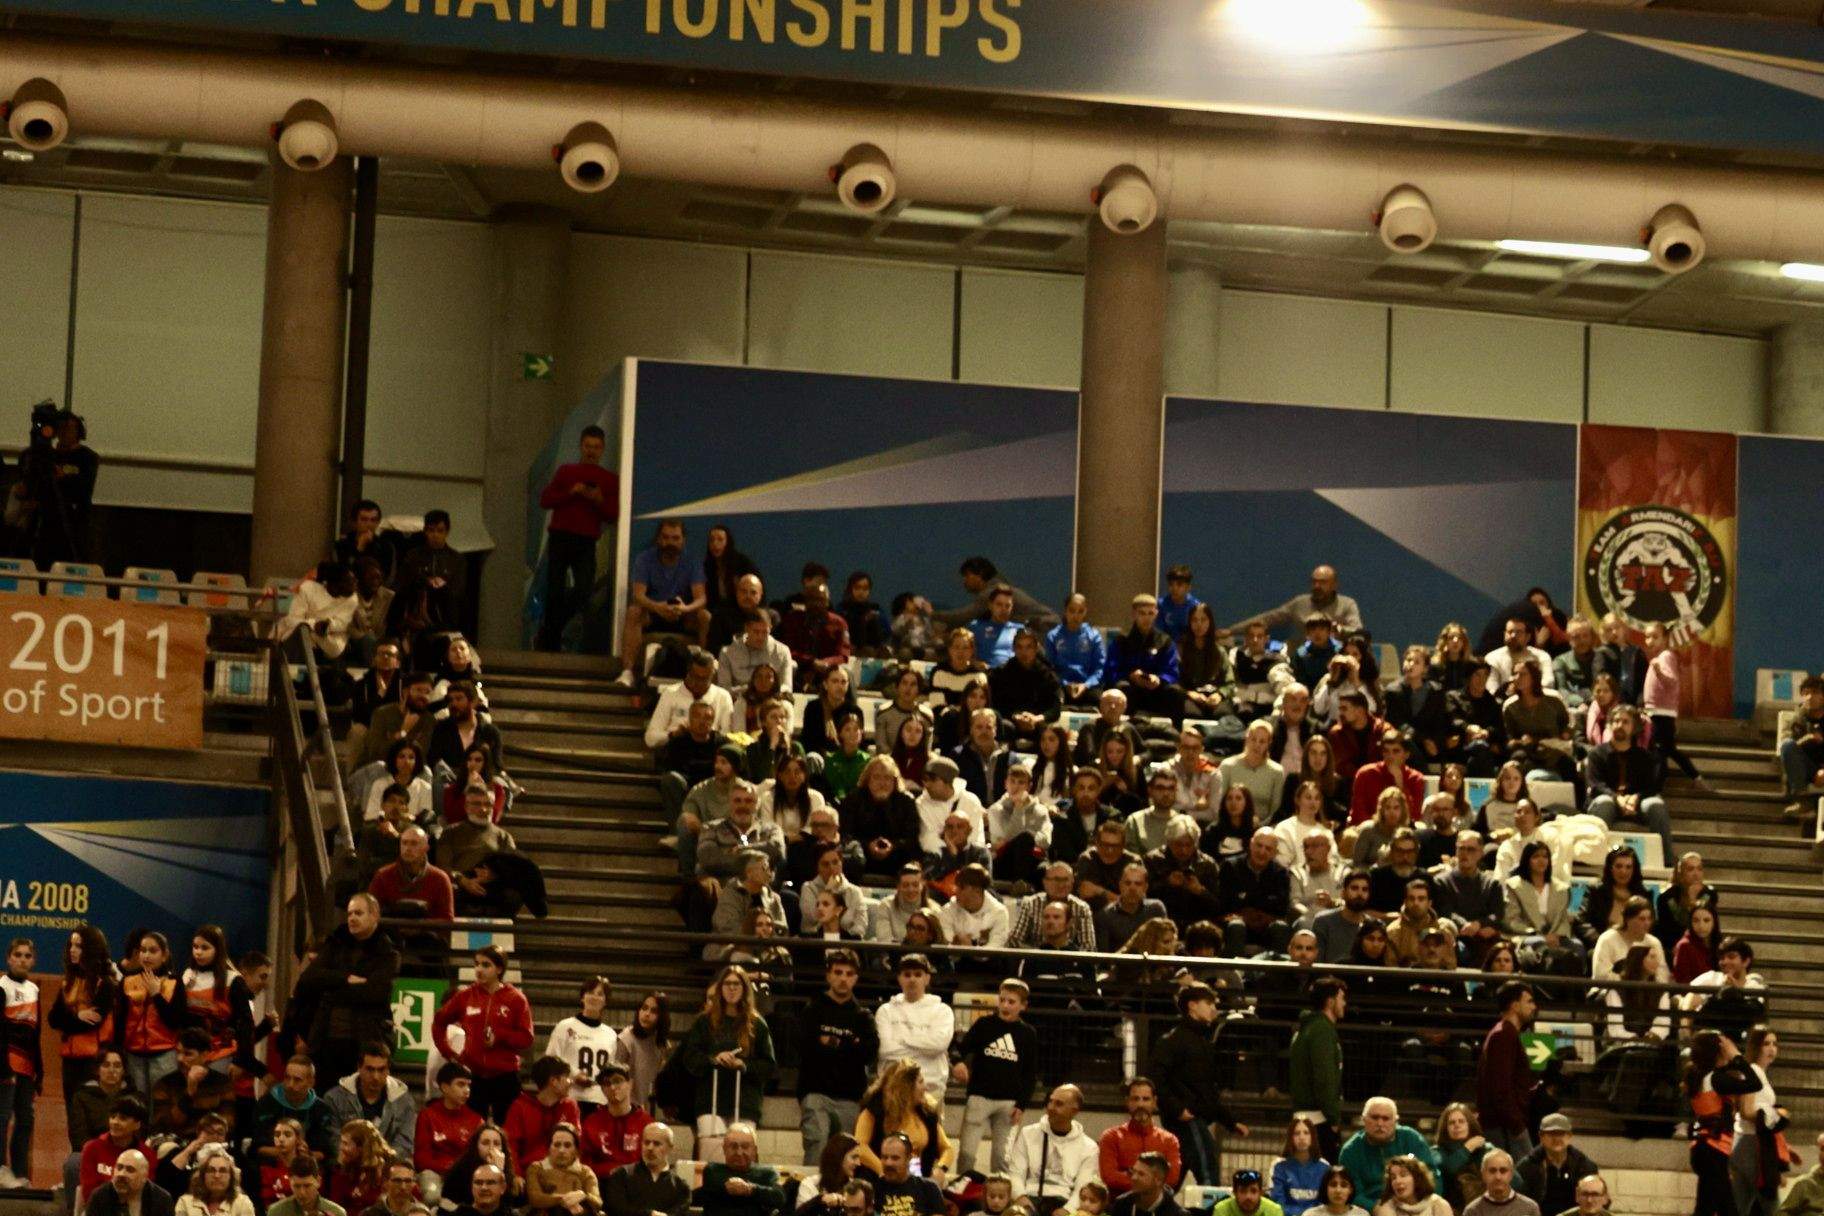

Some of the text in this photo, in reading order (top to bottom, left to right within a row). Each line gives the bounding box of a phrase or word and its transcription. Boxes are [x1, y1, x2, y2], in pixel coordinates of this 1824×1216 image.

[353, 0, 1022, 63] IONSHIPS
[9, 611, 169, 680] 2011
[3, 679, 165, 726] of Sport
[28, 881, 88, 913] 2008
